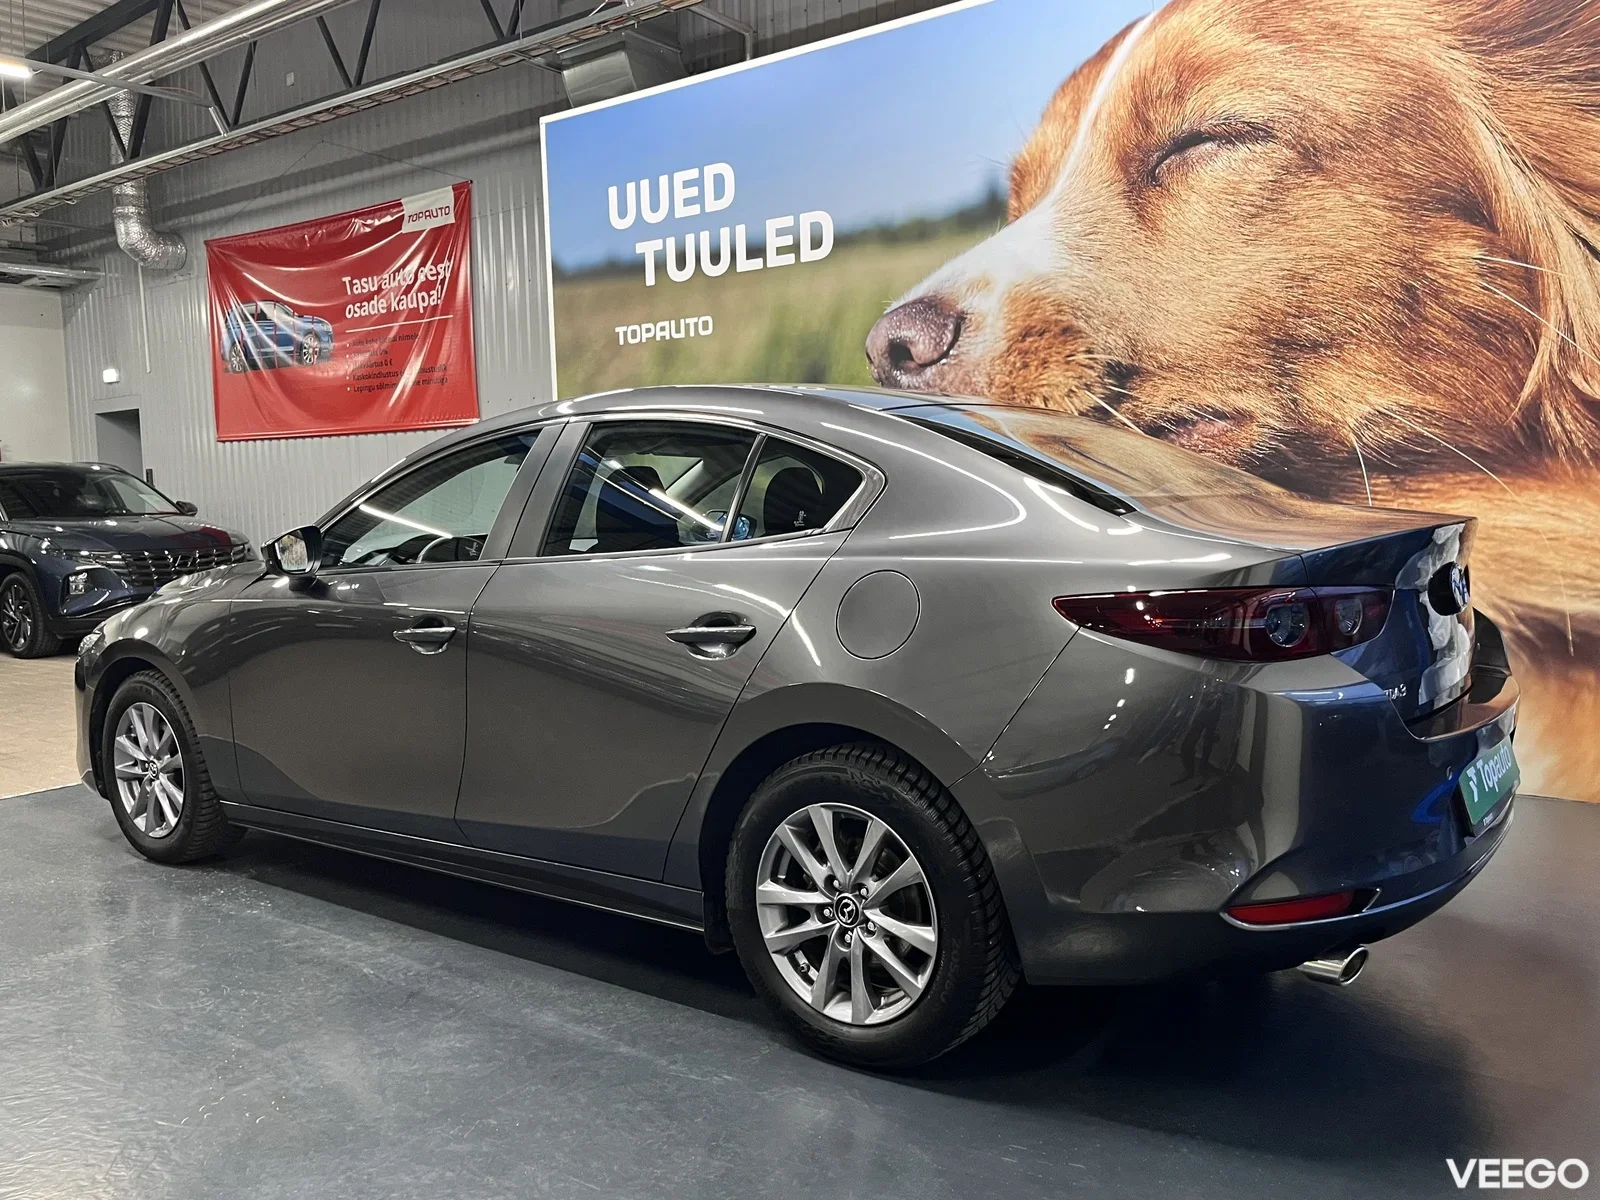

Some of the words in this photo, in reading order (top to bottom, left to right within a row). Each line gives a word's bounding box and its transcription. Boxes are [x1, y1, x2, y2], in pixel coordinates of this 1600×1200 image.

[607, 162, 736, 230] UUED
[407, 205, 451, 224] TOPAUTO
[635, 210, 834, 287] TUULED
[342, 276, 378, 296] Tasu
[381, 268, 415, 290] auto
[417, 260, 451, 283] eest
[345, 295, 387, 319] osade
[390, 285, 442, 314] kaupa!
[614, 315, 714, 346] TOPAUTO
[353, 382, 376, 393] Lepingu
[1476, 744, 1512, 793] Topauto
